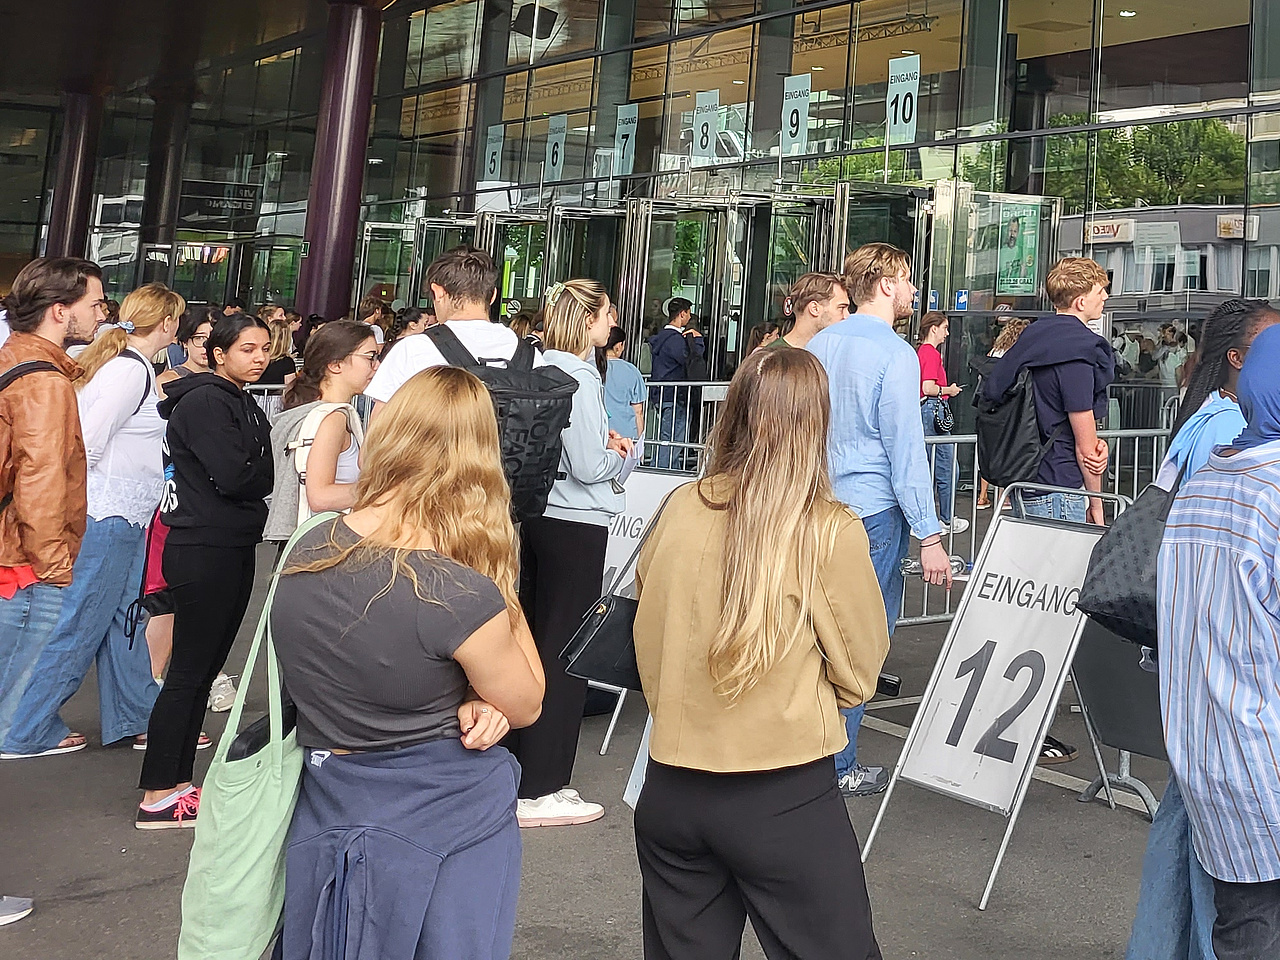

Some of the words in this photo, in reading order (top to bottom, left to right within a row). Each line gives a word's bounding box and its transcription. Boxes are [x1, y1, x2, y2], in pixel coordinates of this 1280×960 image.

[889, 71, 918, 85] EINGANG
[784, 88, 810, 100] EINGANG
[618, 116, 637, 126] EINGANG
[696, 103, 718, 115] EINGANG
[889, 92, 913, 126] 10
[699, 121, 709, 150] 8
[788, 108, 800, 139] 9
[551, 141, 559, 167] 6
[621, 133, 630, 160] 7
[489, 151, 497, 175] 5
[977, 572, 1081, 617] EINGANG
[945, 639, 1046, 764] 12
